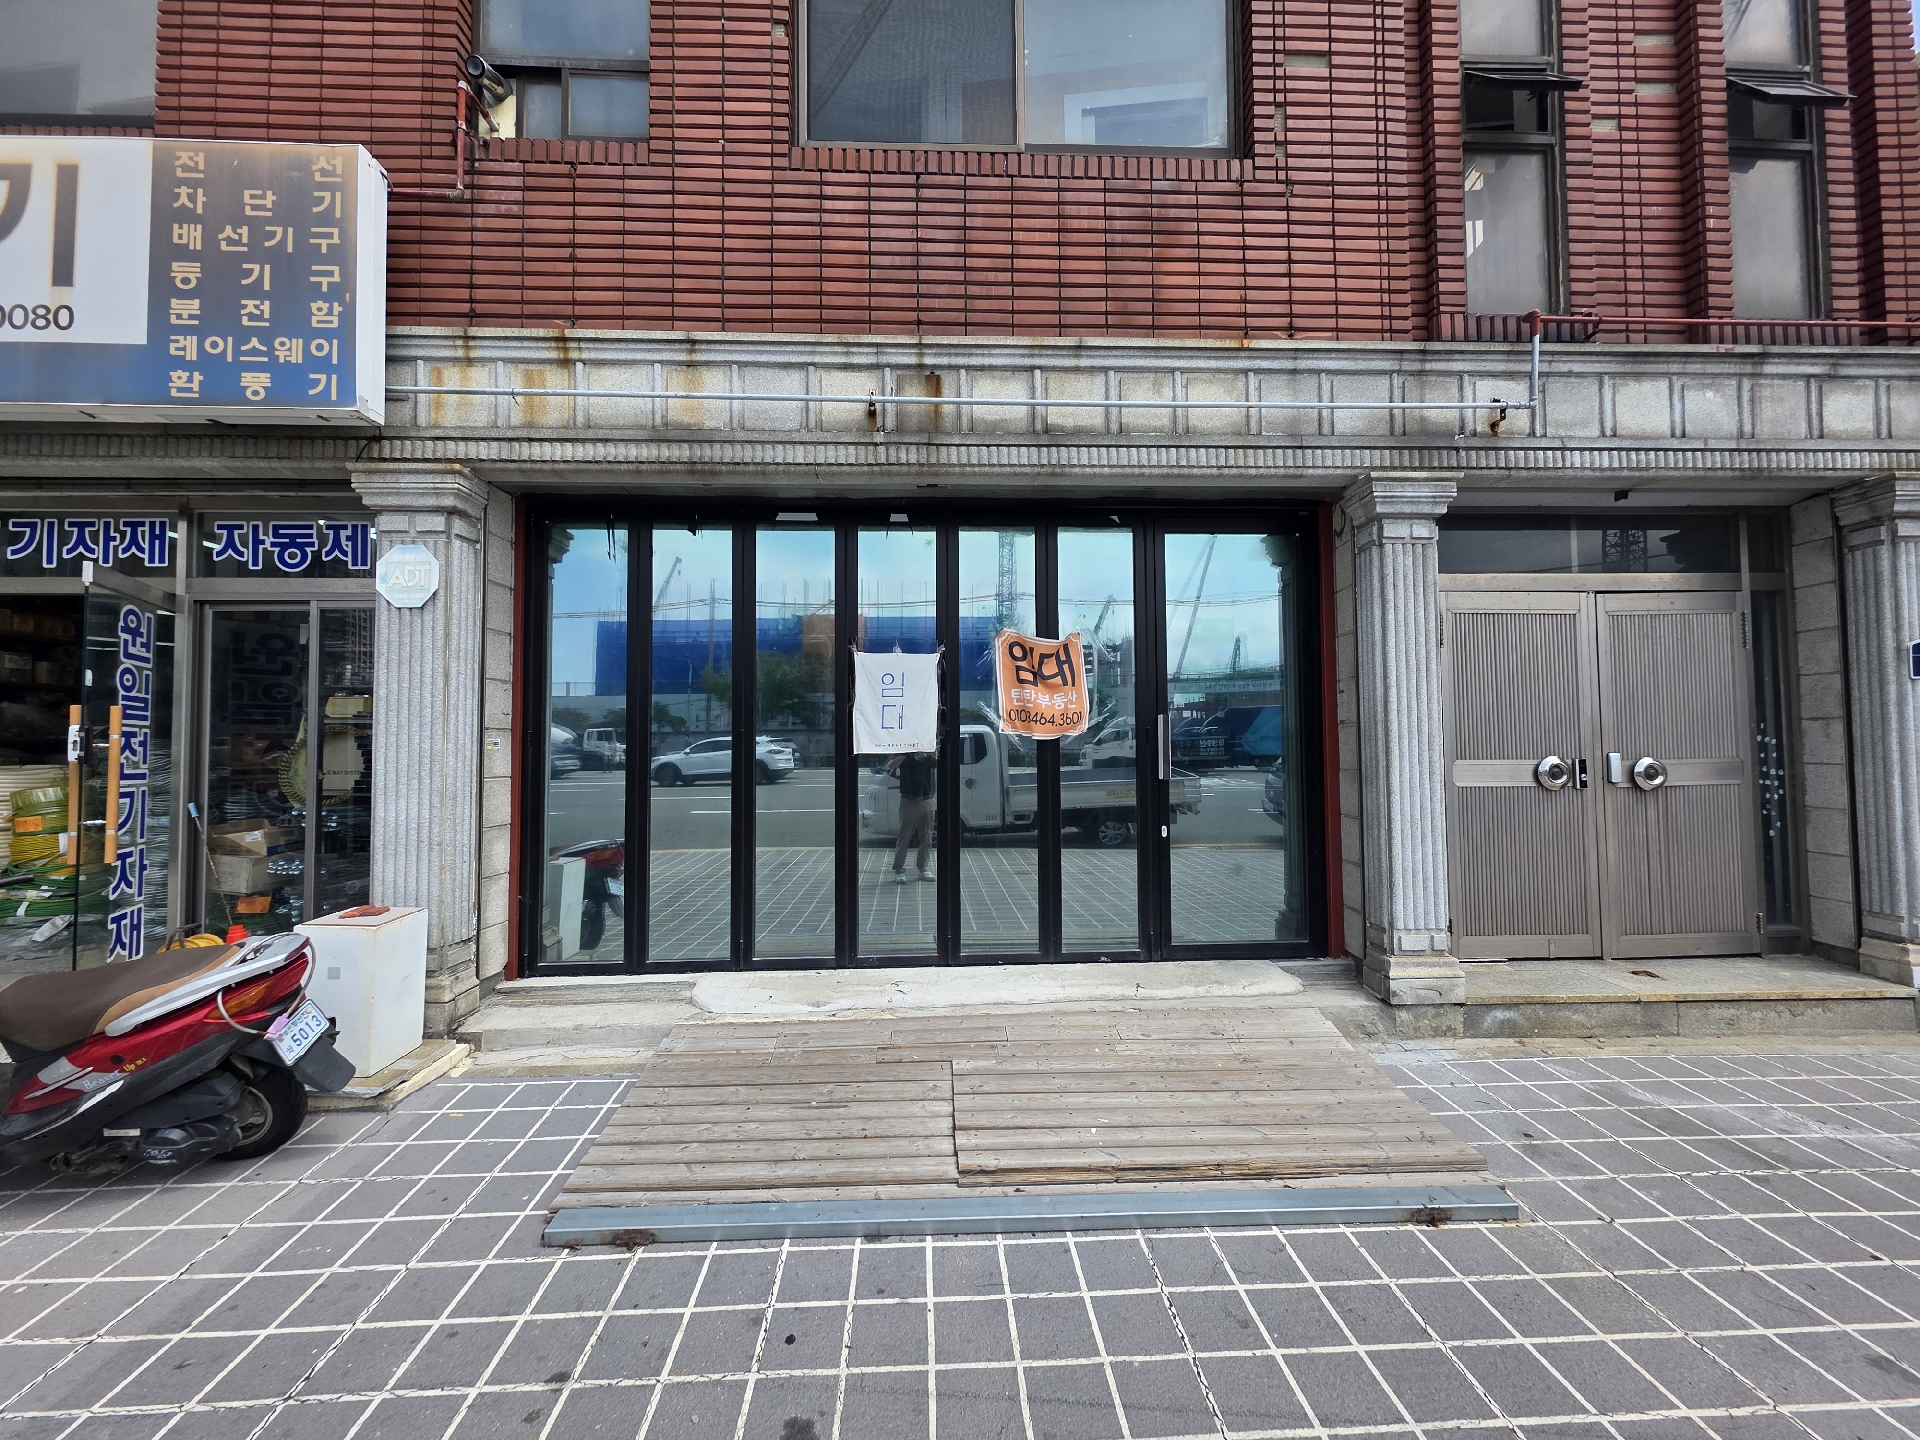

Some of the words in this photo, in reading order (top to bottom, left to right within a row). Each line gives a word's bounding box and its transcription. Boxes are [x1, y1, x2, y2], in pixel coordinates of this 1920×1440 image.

[0, 303, 75, 331] 080
[7, 518, 169, 568] 기자재
[213, 521, 371, 572] 자동제
[386, 564, 431, 587] ADT
[1008, 640, 1076, 688] 임대
[881, 671, 905, 730] 임대
[291, 1014, 322, 1047] 5013
[80, 1068, 121, 1091] Beaver
